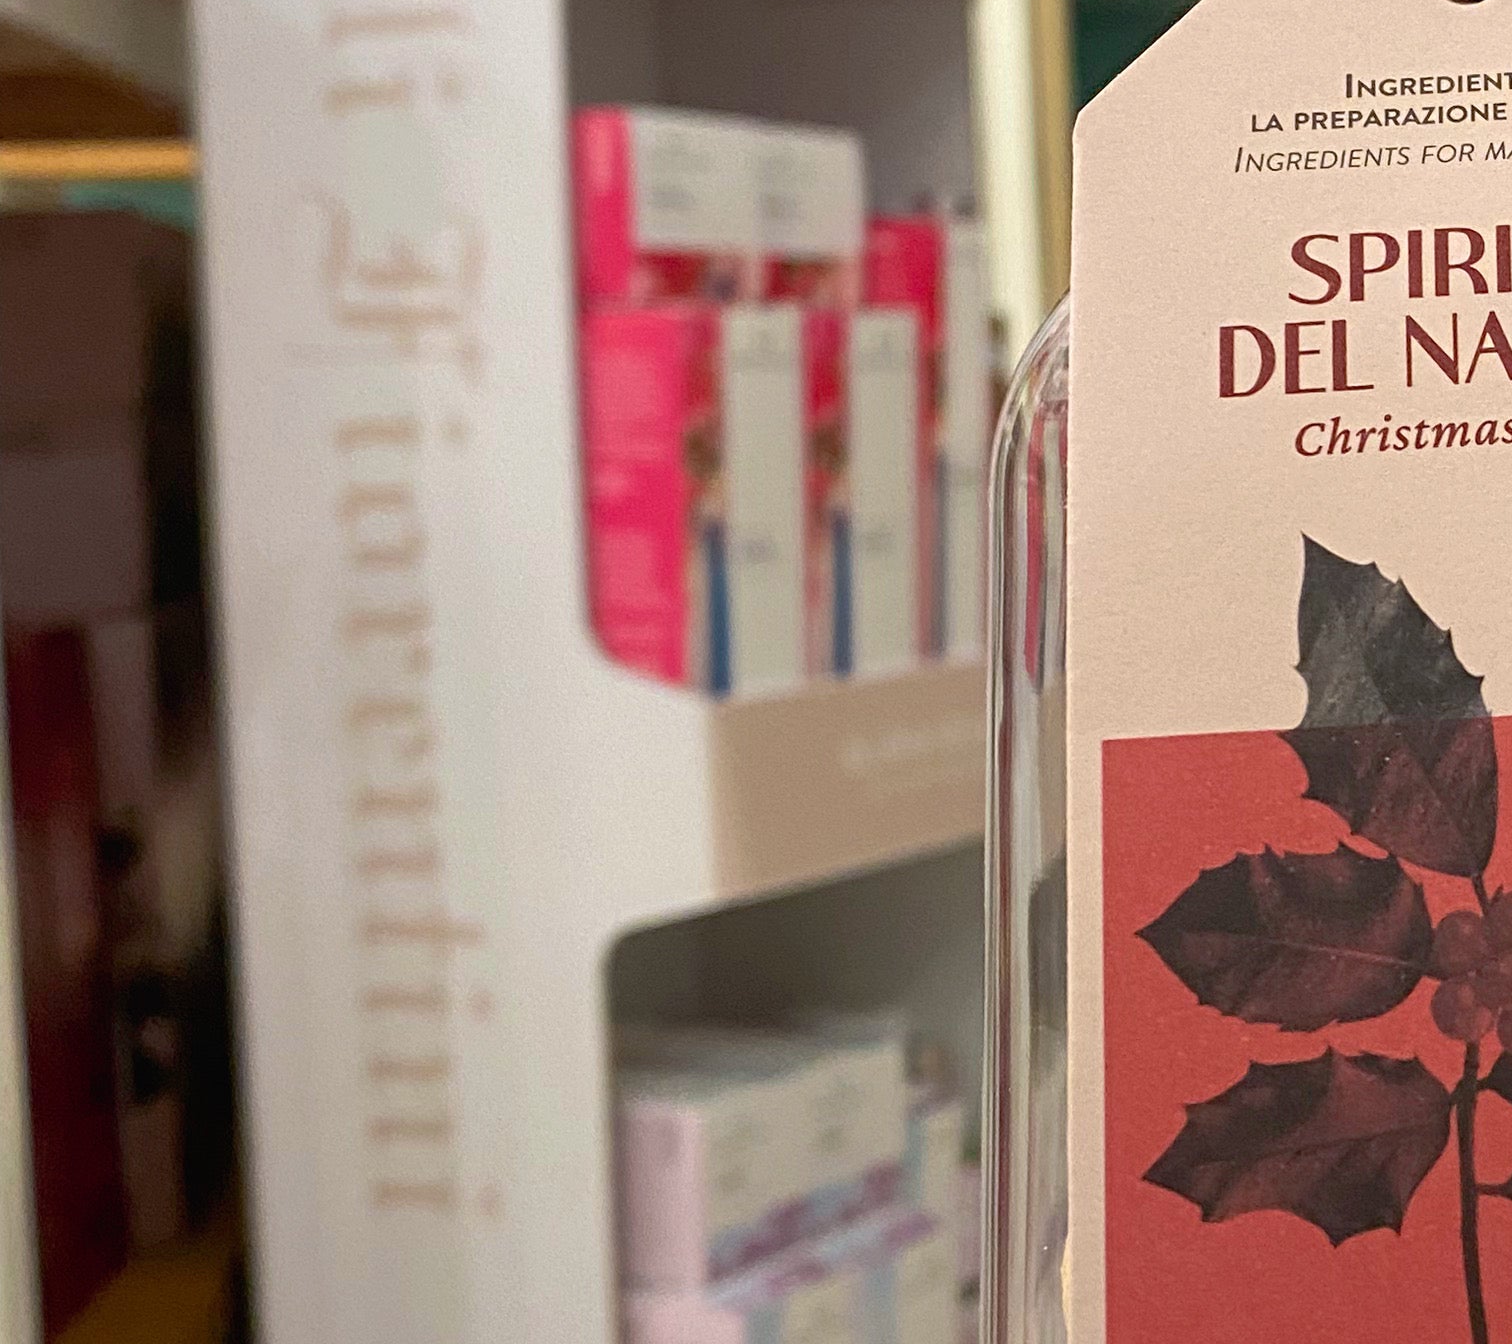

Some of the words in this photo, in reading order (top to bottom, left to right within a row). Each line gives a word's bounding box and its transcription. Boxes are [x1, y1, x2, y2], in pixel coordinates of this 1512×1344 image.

[1251, 113, 1284, 133] LA
[1294, 102, 1508, 131] PREPARAZIONE
[1421, 143, 1475, 165] FOR
[1219, 319, 1375, 398] DEL
